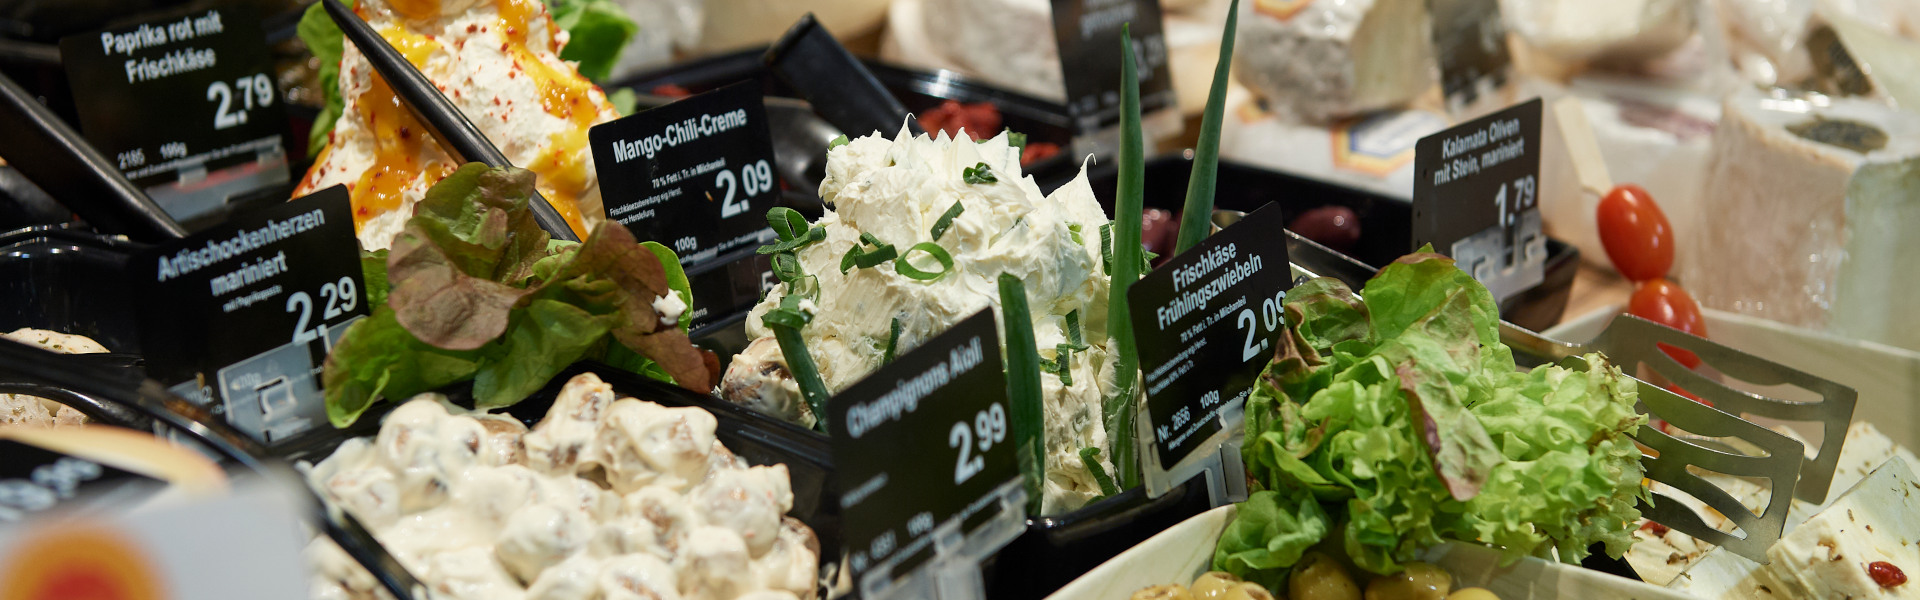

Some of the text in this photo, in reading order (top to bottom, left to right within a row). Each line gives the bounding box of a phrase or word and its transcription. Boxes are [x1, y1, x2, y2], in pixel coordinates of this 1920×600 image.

[101, 10, 223, 55] Paprika rot mit
[125, 47, 216, 83] Frischkäse
[207, 73, 274, 129] 2.79
[117, 148, 146, 169] 2185
[612, 108, 747, 163] Mango-Chili-Creme
[1434, 136, 1525, 186] mit Stein, mariniert
[1442, 118, 1520, 159] Kalamata Oliven
[652, 178, 660, 189] 70
[660, 176, 666, 186] %
[666, 173, 677, 184] Fett
[682, 168, 690, 179] Tr.
[690, 166, 696, 176] in
[696, 157, 726, 175] Milchanteil
[715, 159, 773, 220] 2.09
[1495, 174, 1535, 228] 1.79
[158, 208, 325, 282] Artischockenherzen
[675, 236, 697, 252] 100g
[1172, 242, 1237, 293] Frischkäse
[210, 250, 288, 297] mariniert
[1157, 253, 1263, 331] Frühlingszwiebeln
[286, 276, 358, 343] 2.29
[846, 361, 950, 439] Champignons
[1157, 425, 1172, 443] Nr.
[1171, 405, 1191, 431] 2656
[1200, 390, 1220, 409] 100g
[949, 402, 1007, 485] 2.99
